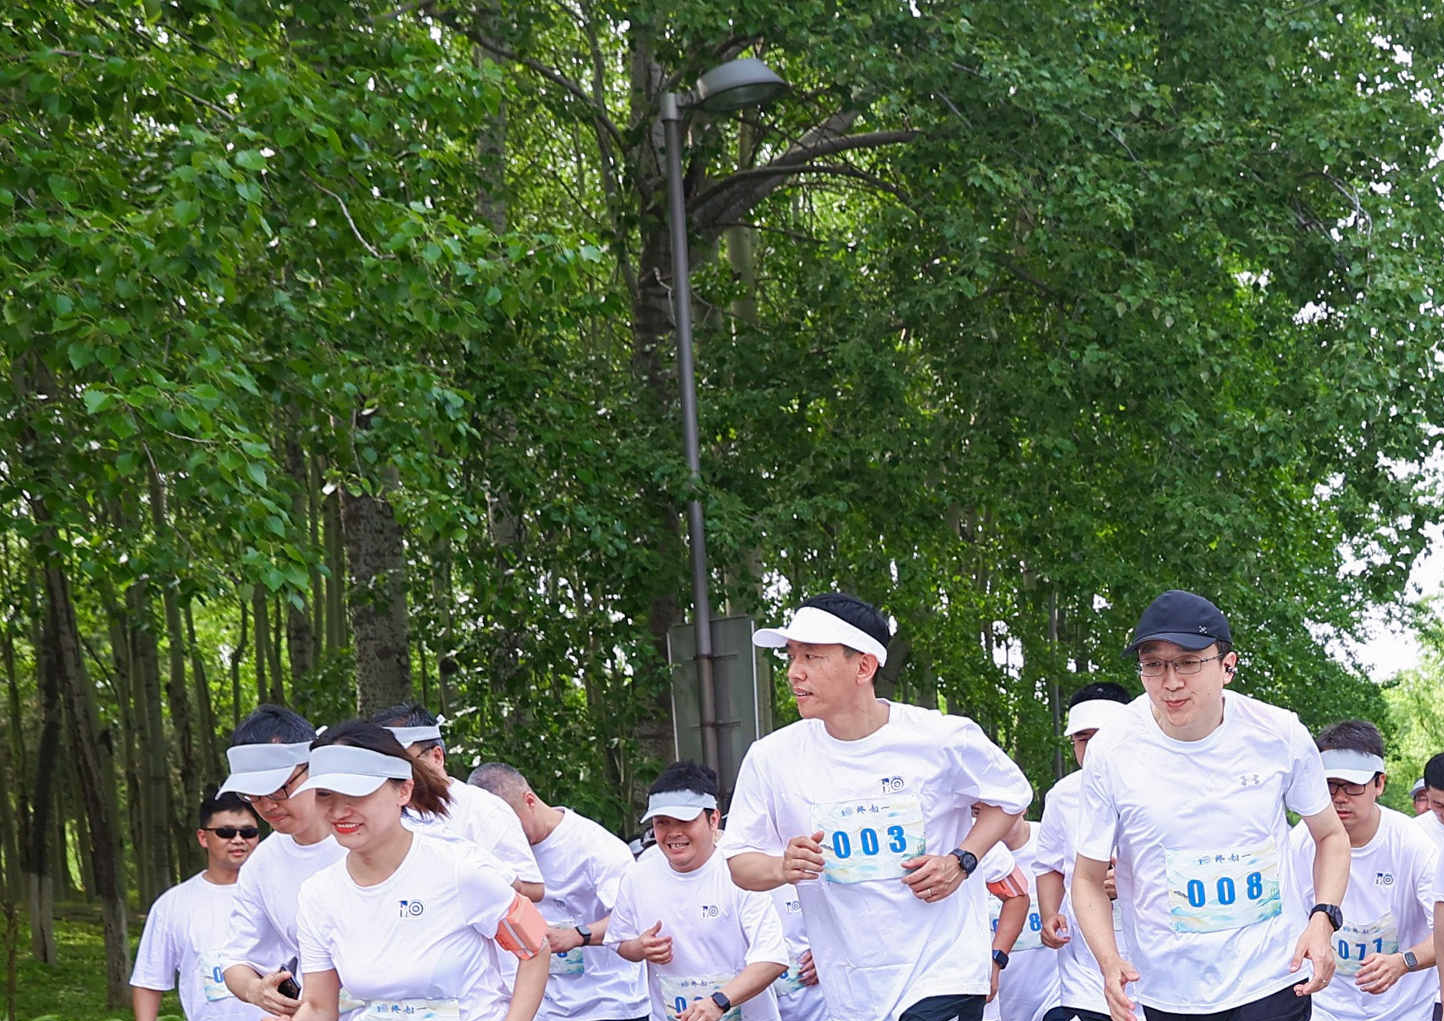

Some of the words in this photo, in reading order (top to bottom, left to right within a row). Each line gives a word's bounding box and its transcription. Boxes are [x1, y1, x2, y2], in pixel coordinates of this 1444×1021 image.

[832, 825, 907, 859] 003
[1187, 871, 1263, 908] 008
[1337, 937, 1383, 961] 071
